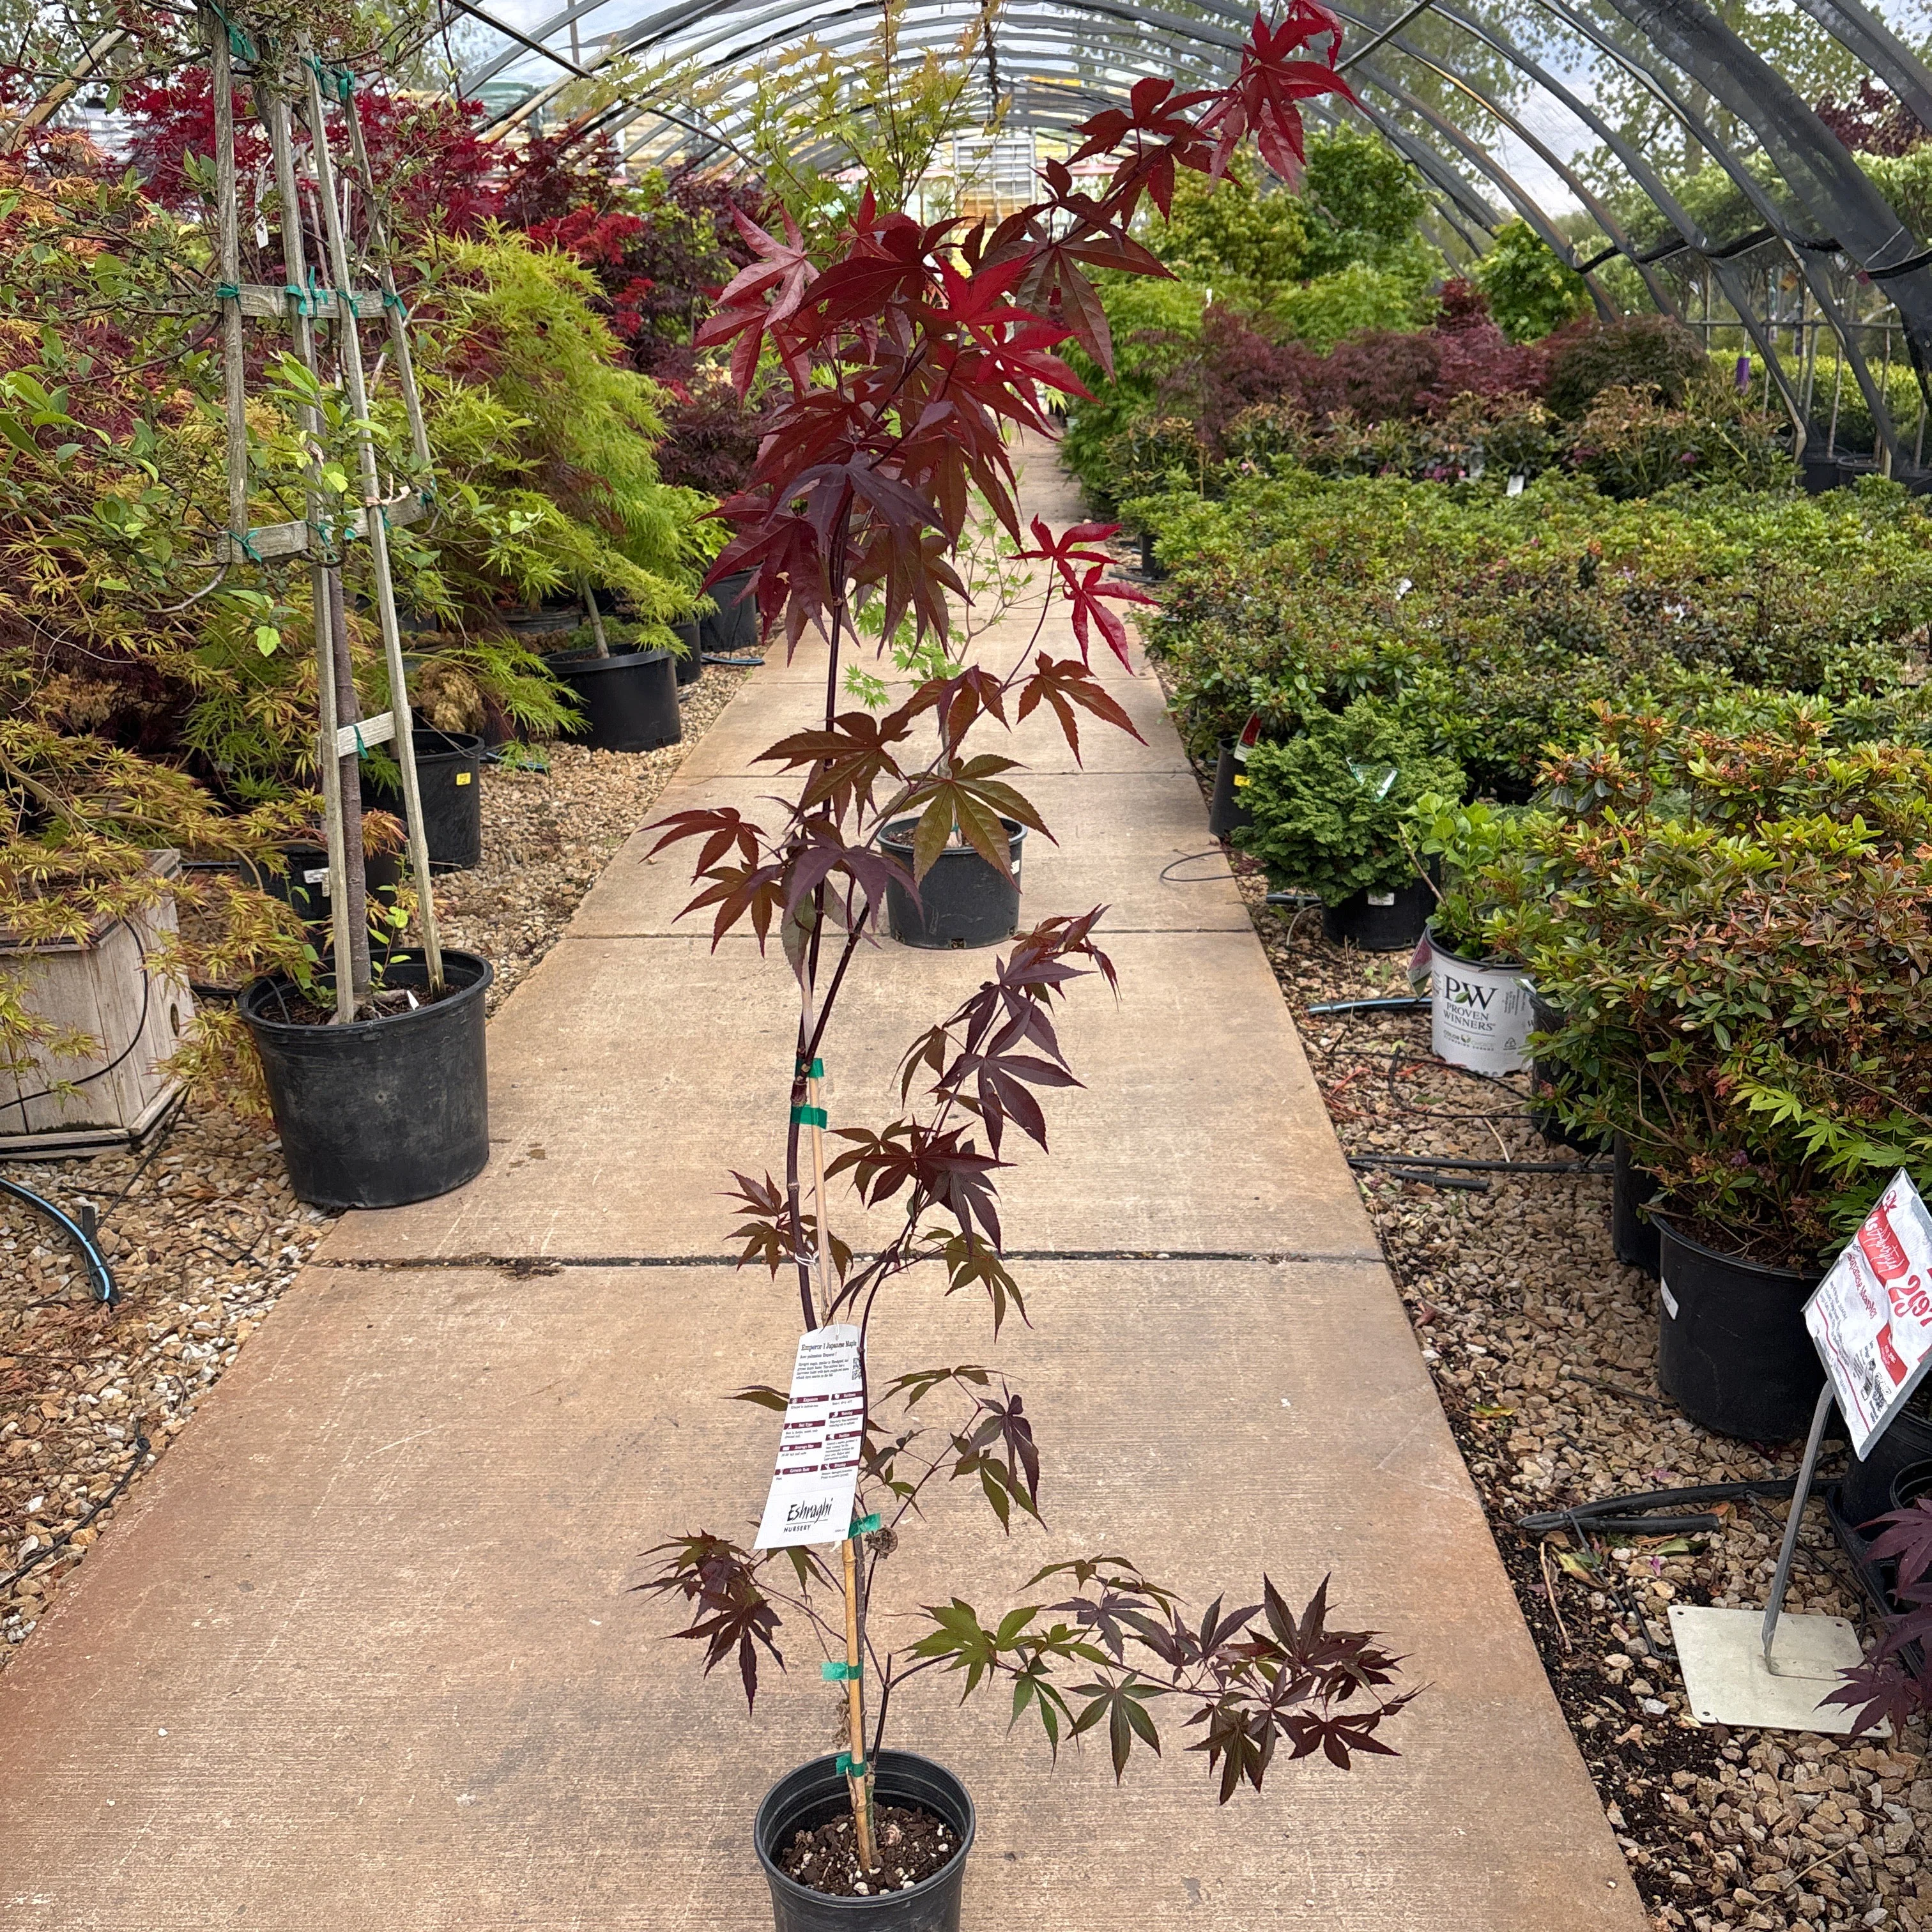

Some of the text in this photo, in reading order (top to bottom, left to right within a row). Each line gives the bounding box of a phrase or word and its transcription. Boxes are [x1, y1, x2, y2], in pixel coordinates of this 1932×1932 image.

[1444, 974, 1499, 1011] PW
[1446, 1002, 1489, 1021] PROVEN
[786, 1498, 834, 1524] Eshraghi
[783, 1524, 811, 1533] NURSERY
